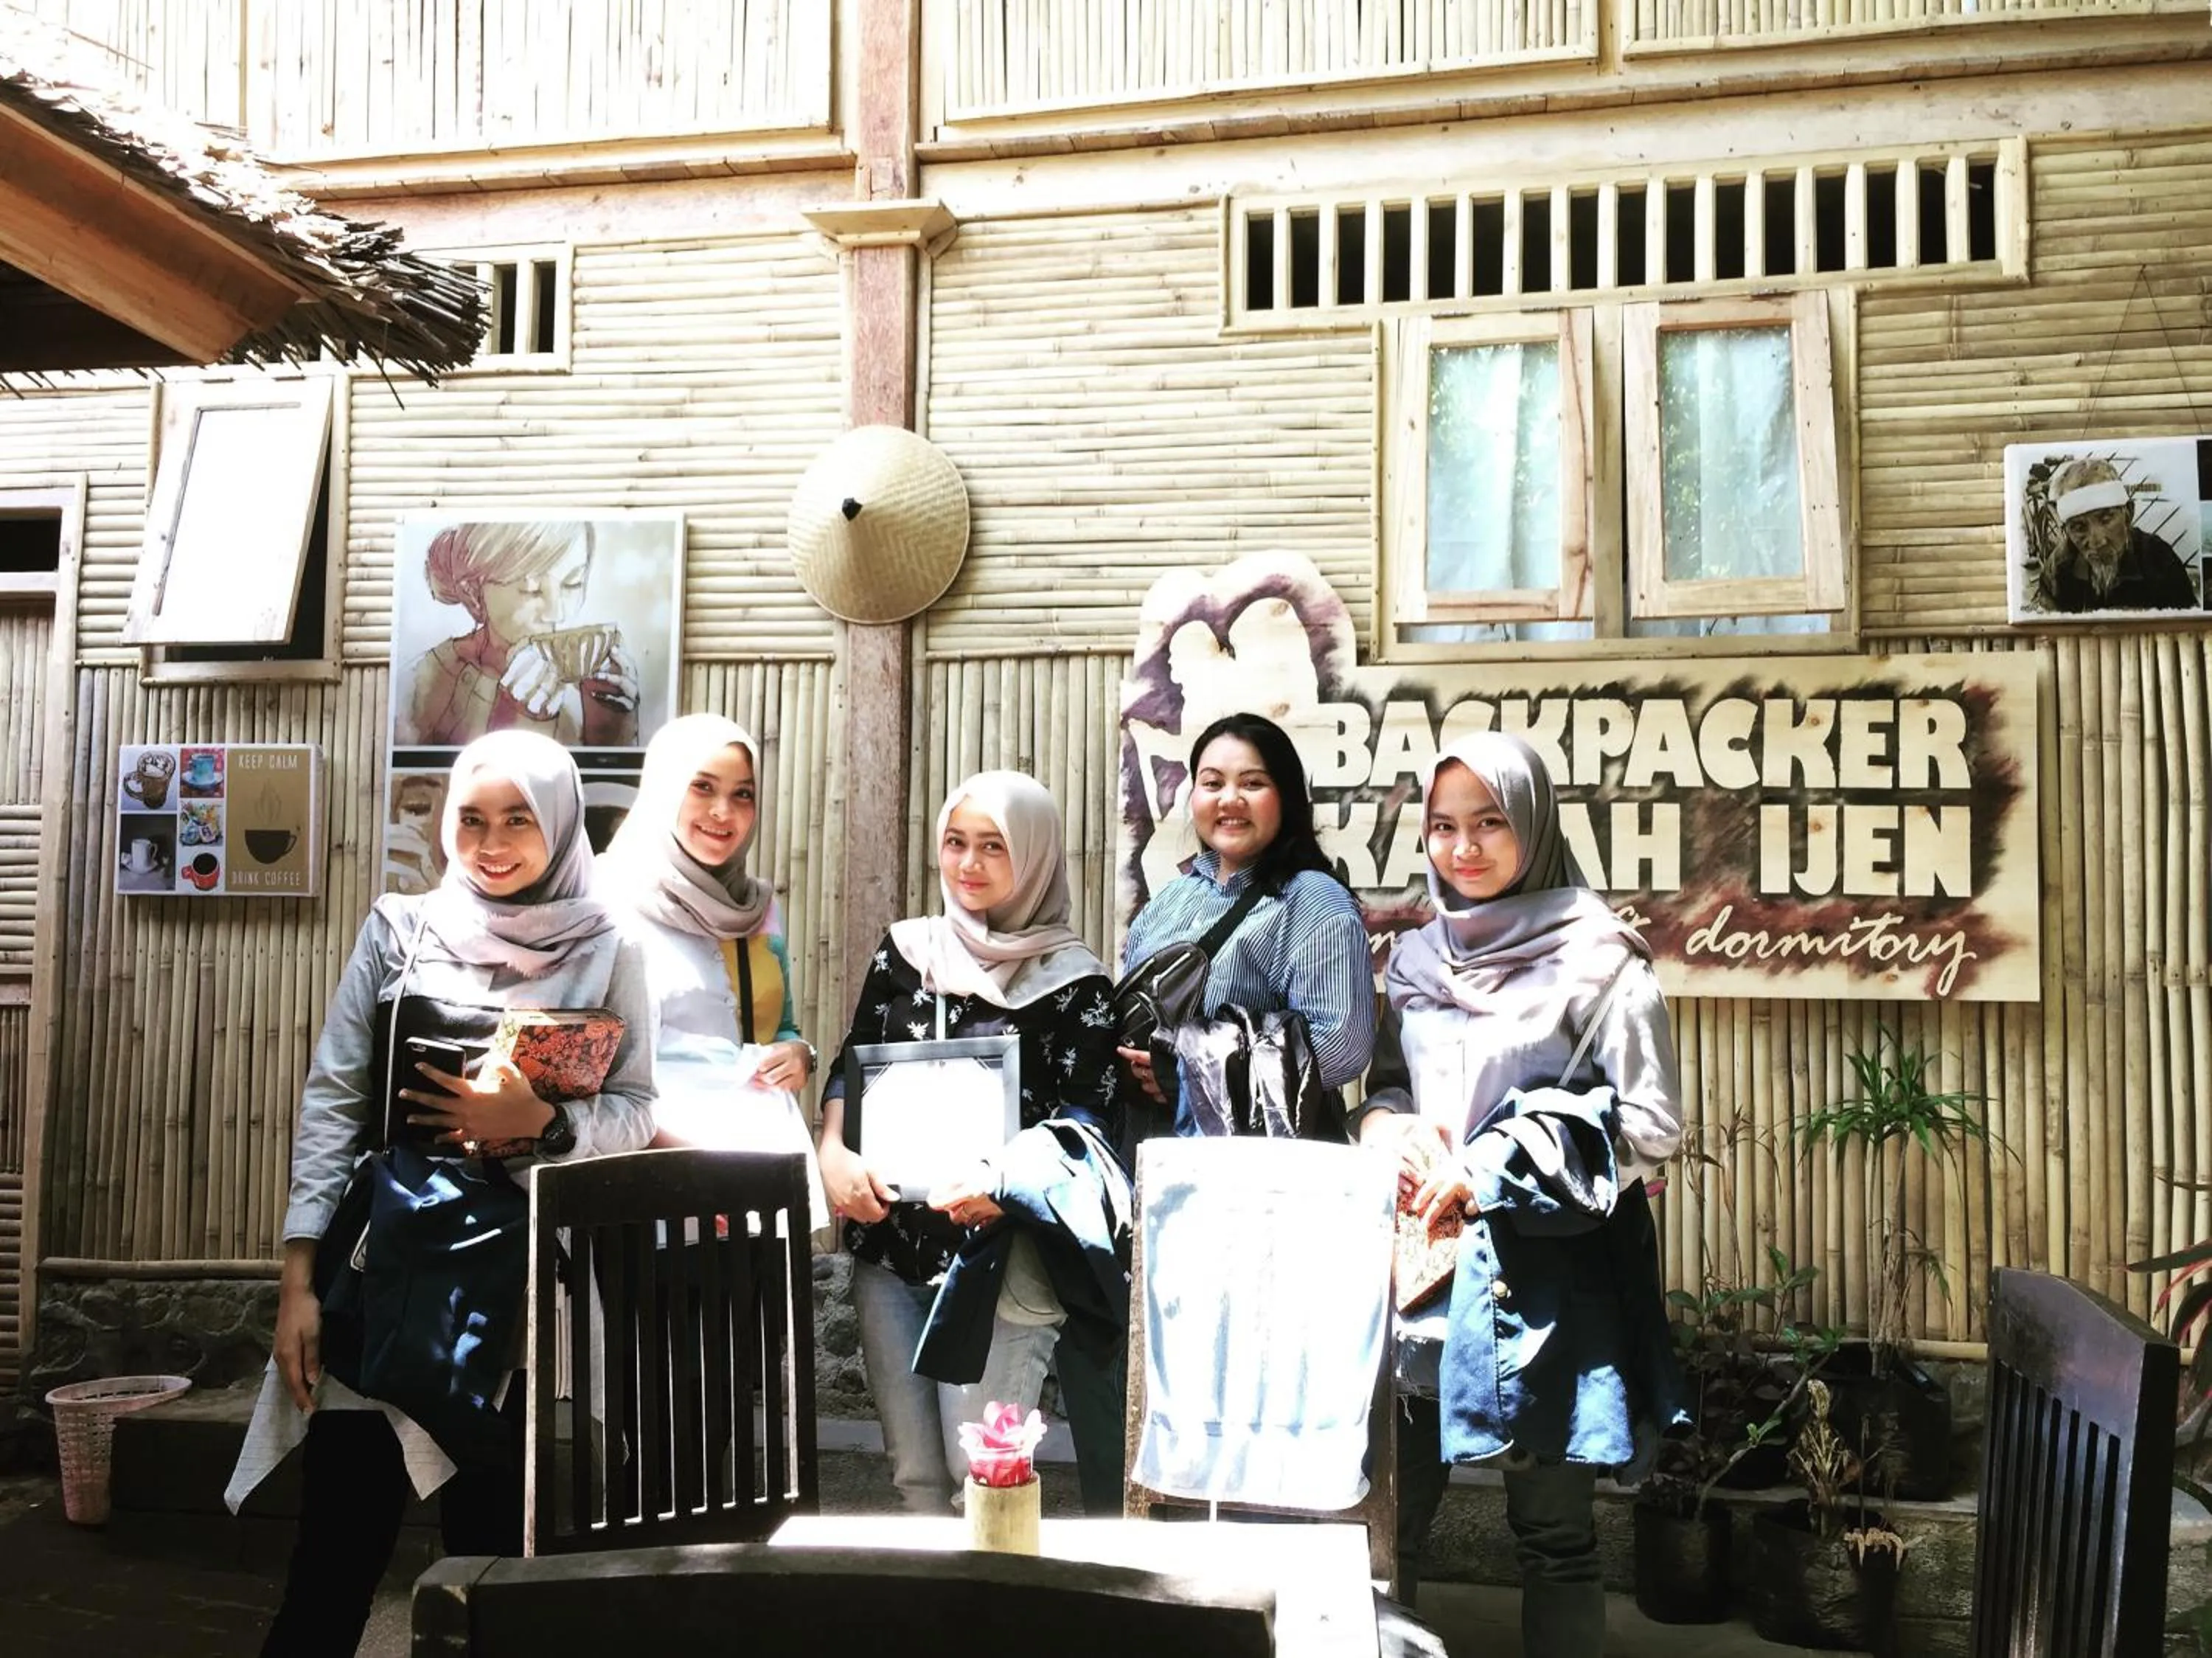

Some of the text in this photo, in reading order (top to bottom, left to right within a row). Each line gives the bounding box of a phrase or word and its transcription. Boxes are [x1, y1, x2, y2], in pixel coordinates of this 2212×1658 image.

[238, 755, 298, 769] KEEP CALM
[1312, 801, 1972, 897] KAAH IJEN
[232, 871, 301, 886] DRINK COFFEE
[1685, 905, 1977, 996] dormitory
